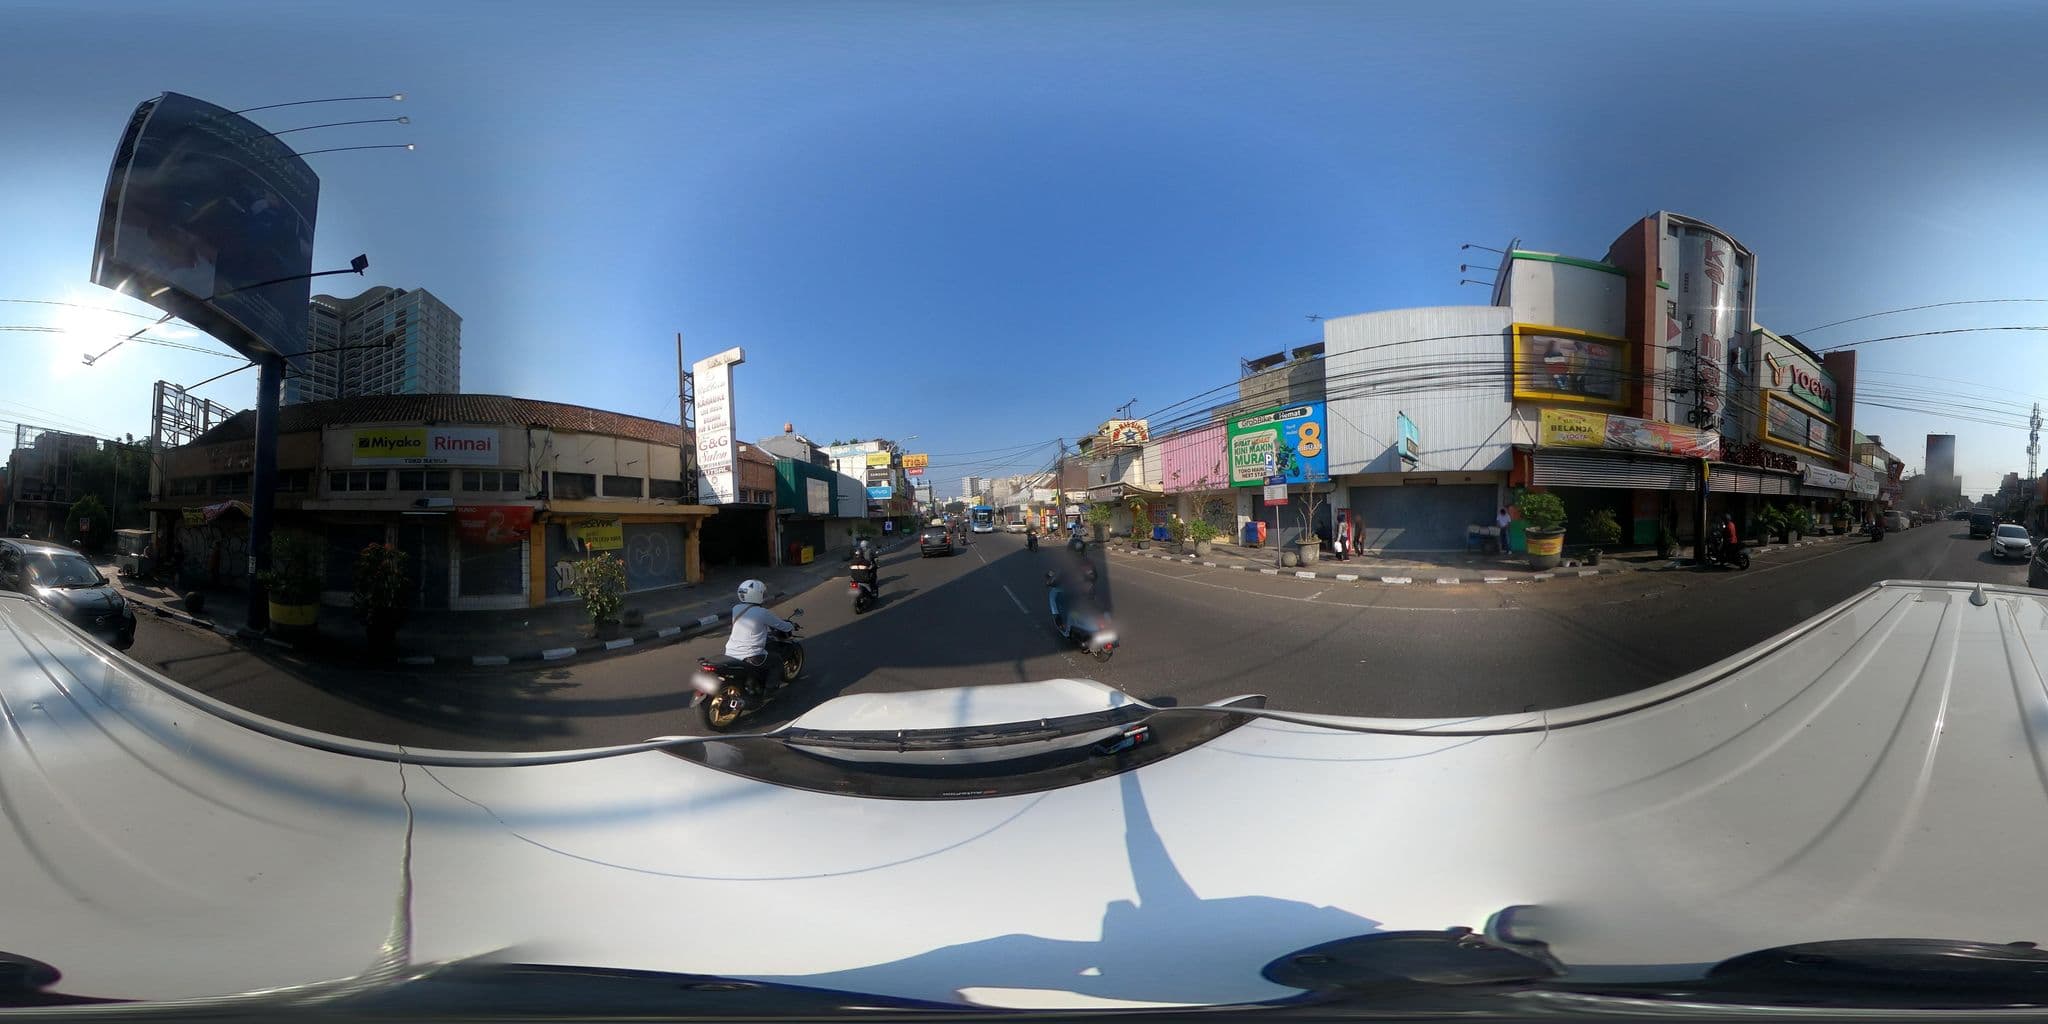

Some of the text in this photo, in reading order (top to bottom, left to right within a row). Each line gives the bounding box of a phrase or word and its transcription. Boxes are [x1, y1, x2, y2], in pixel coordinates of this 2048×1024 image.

[1790, 364, 1832, 402] YOGYA
[1241, 415, 1273, 427] GrabBike
[1550, 424, 1594, 433] BELANJA
[371, 436, 492, 452] Miyako Rinnai
[698, 435, 728, 451] G&G
[1298, 421, 1321, 458] 8
[1234, 442, 1273, 455] KINI MAKIN
[1265, 453, 1272, 464] P
